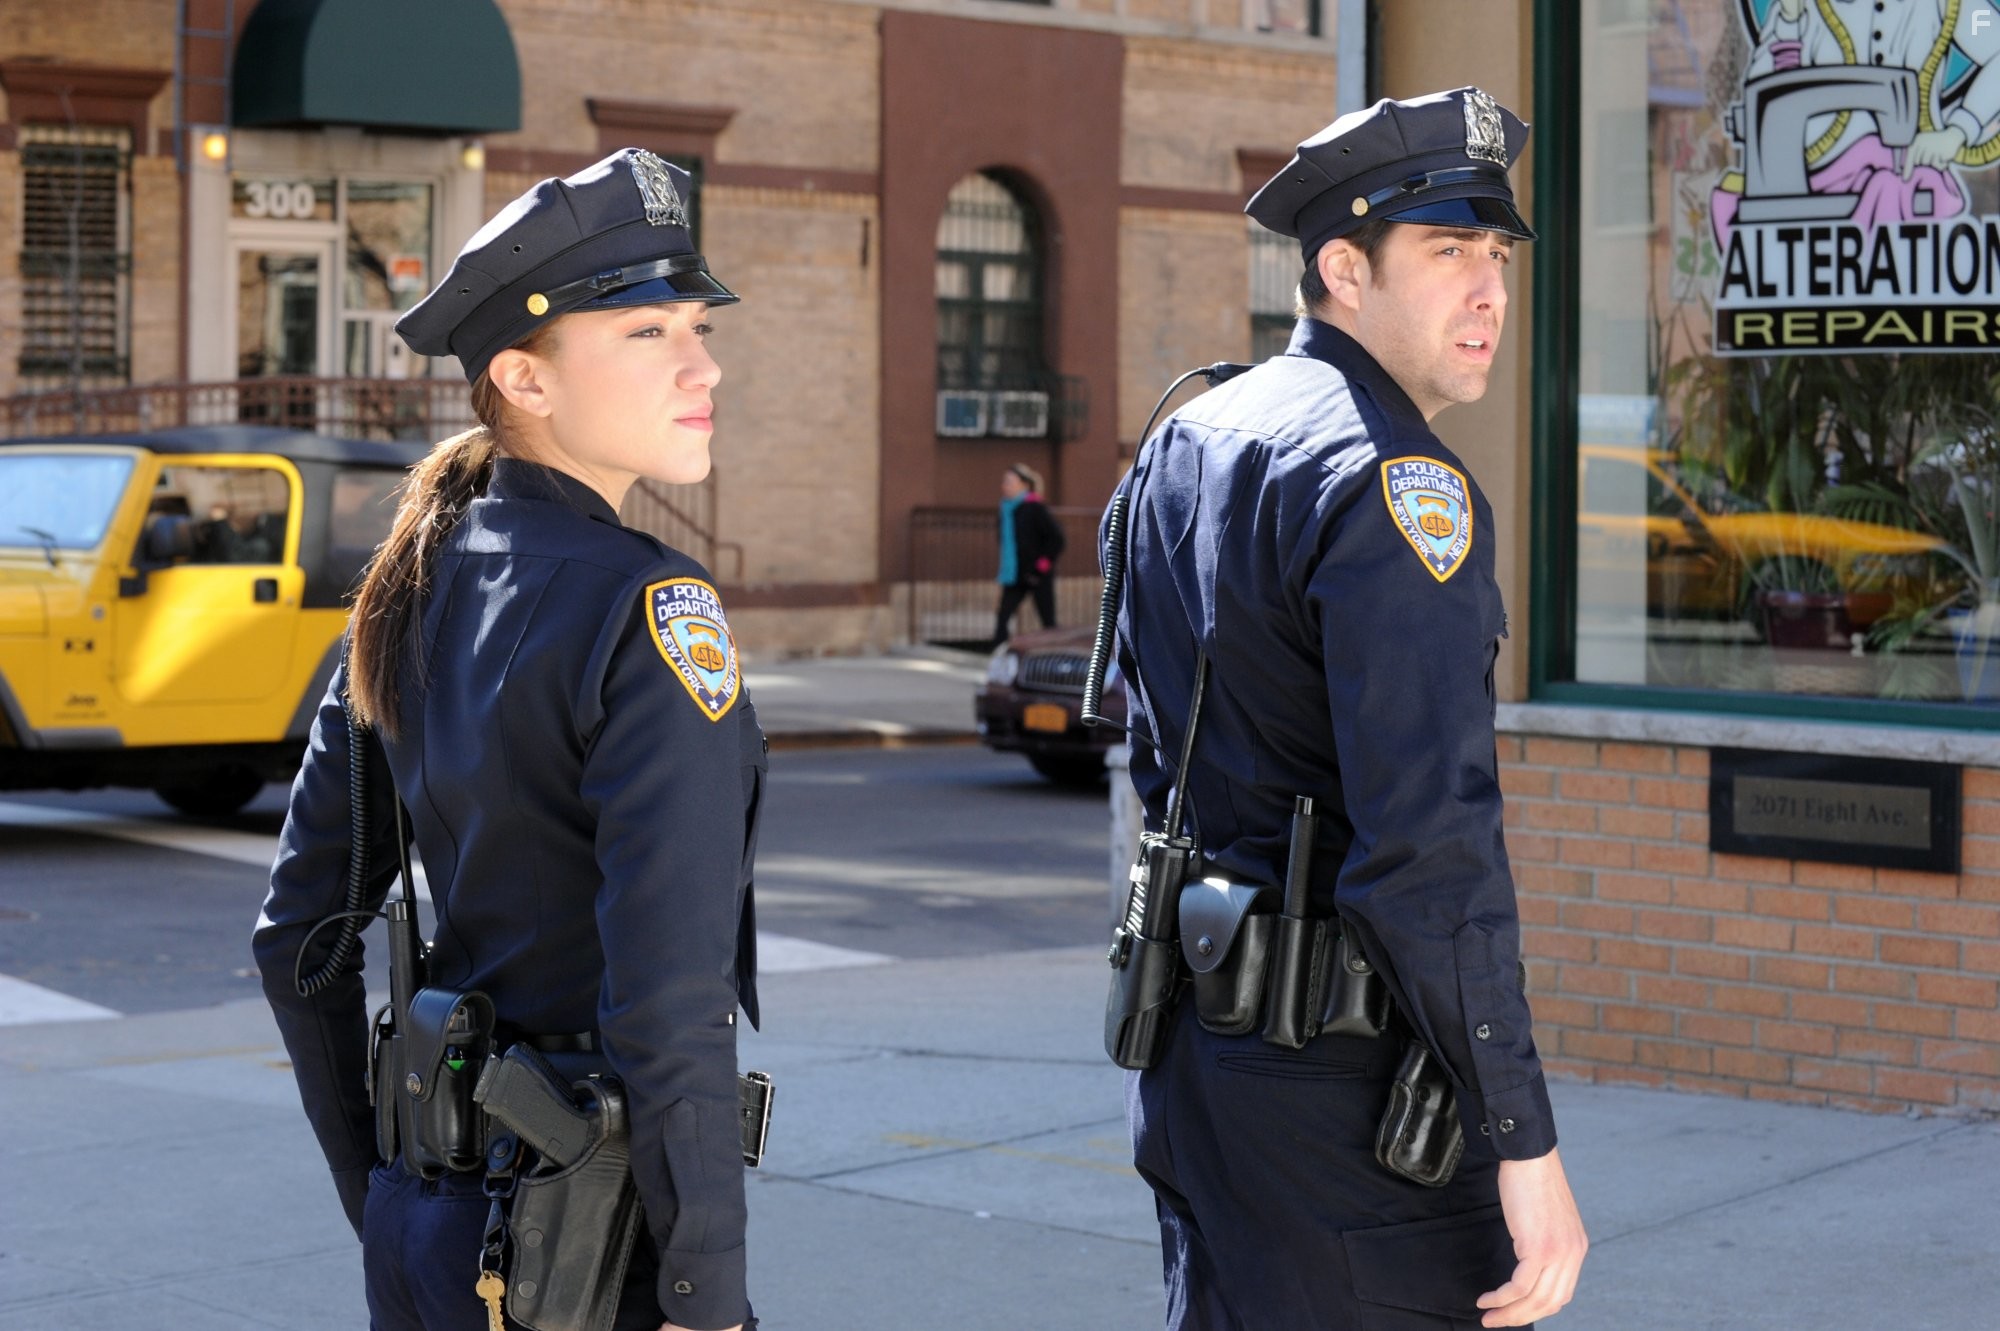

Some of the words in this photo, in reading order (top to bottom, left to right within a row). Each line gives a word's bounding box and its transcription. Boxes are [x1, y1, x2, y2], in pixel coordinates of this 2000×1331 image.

[245, 182, 315, 219] 300
[1734, 310, 2000, 347] REPAIR
[1391, 475, 1464, 503] DEPARTMENT
[1404, 462, 1450, 483] POLICE
[1393, 499, 1411, 530] NEW
[1408, 527, 1433, 558] YORK
[1448, 536, 1467, 560] NEW
[1460, 509, 1469, 540] YORK
[673, 584, 720, 609] POLICE
[658, 627, 679, 661] NEW
[676, 655, 705, 694] YORK
[721, 670, 737, 698] NEW
[1749, 794, 1797, 819] 2071
[1804, 797, 1858, 825] Eight
[1864, 803, 1910, 827] Ave.
